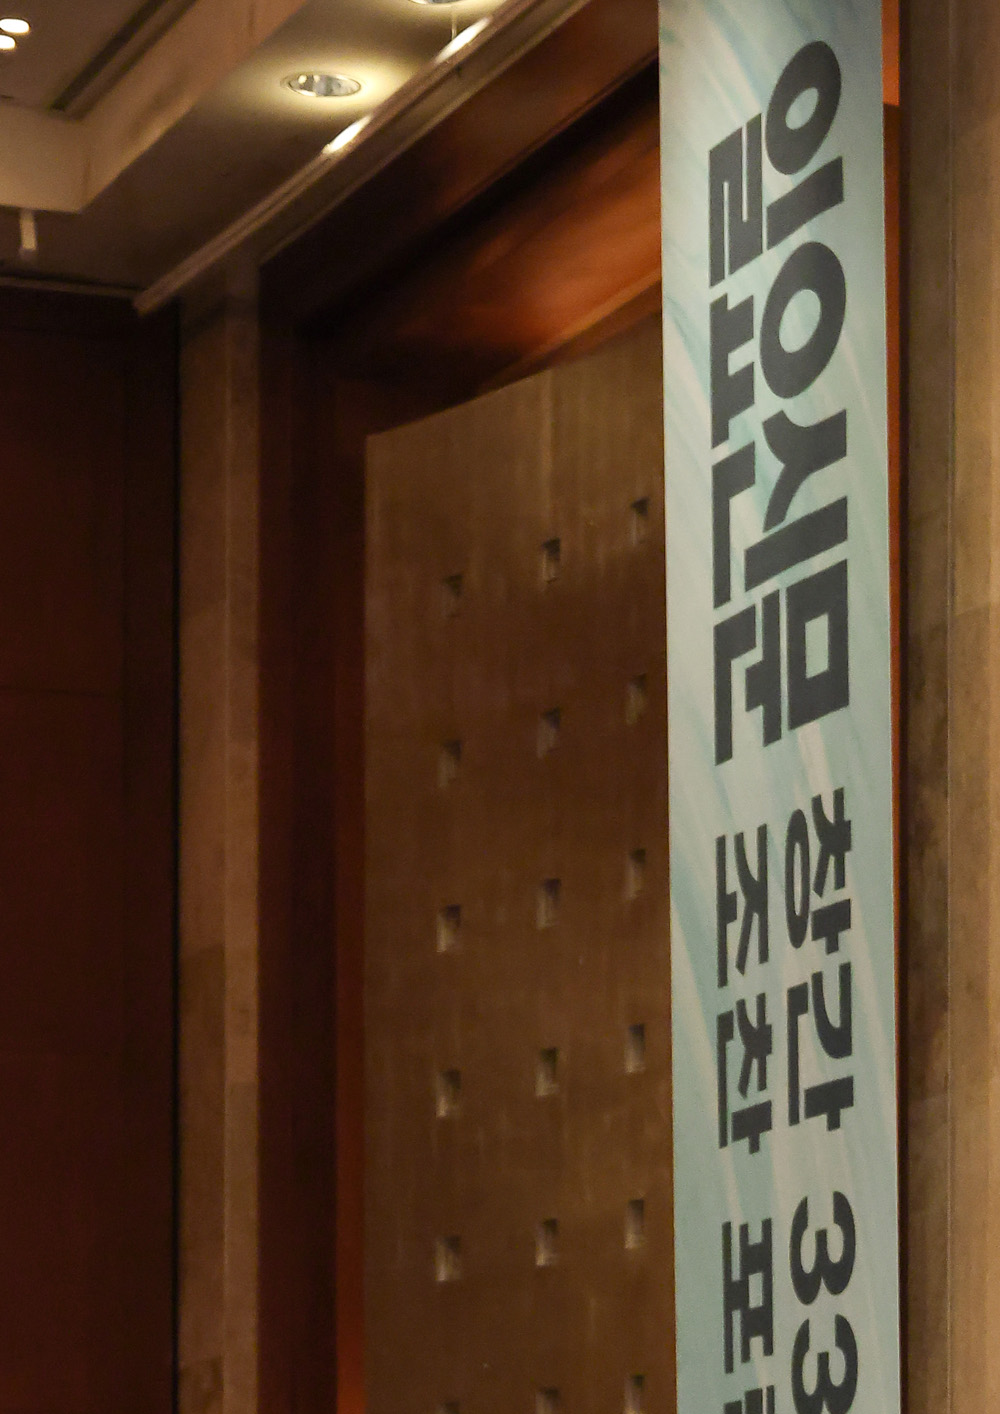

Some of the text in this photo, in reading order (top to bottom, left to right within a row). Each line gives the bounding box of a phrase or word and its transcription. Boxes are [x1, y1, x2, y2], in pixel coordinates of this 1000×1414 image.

[708, 40, 851, 767] 일요신문
[715, 822, 773, 1155] 조찬
[784, 785, 855, 1133] 창간
